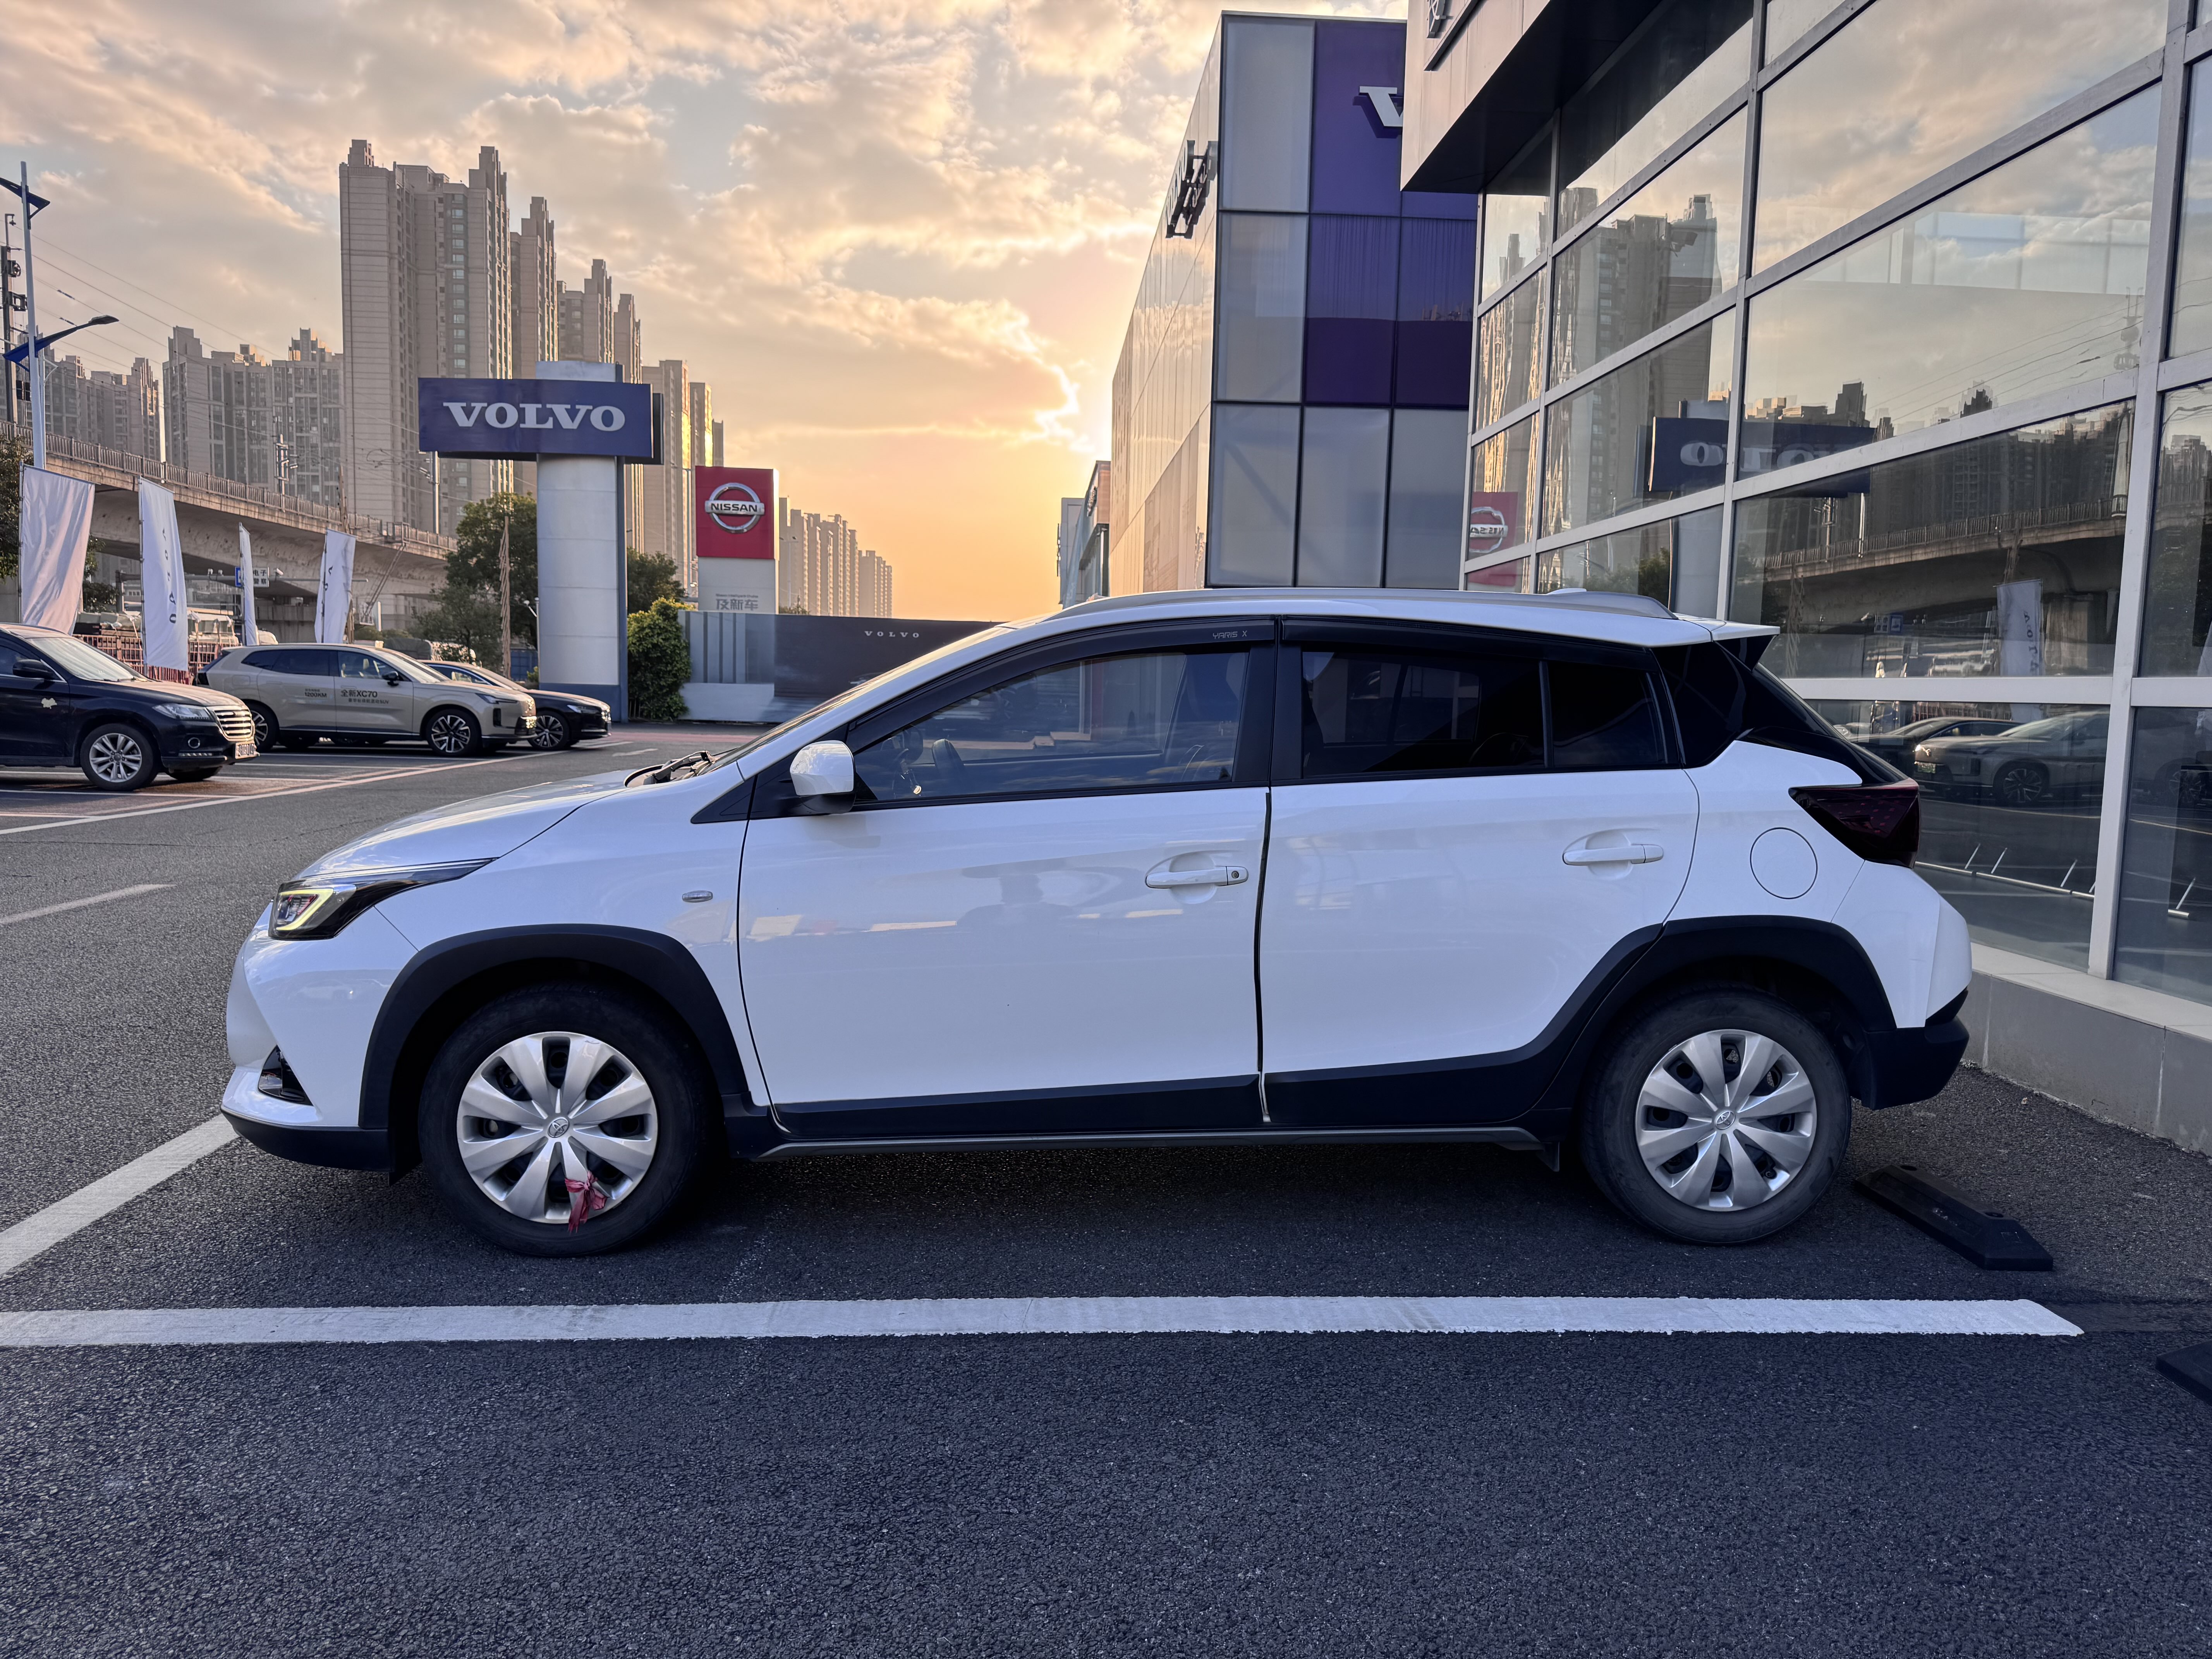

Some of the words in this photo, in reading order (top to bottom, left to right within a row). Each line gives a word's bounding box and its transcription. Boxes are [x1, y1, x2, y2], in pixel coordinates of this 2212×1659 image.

[443, 402, 625, 431] VOLVO
[711, 503, 757, 512] NISSAN
[1212, 631, 1238, 639] YARIS
